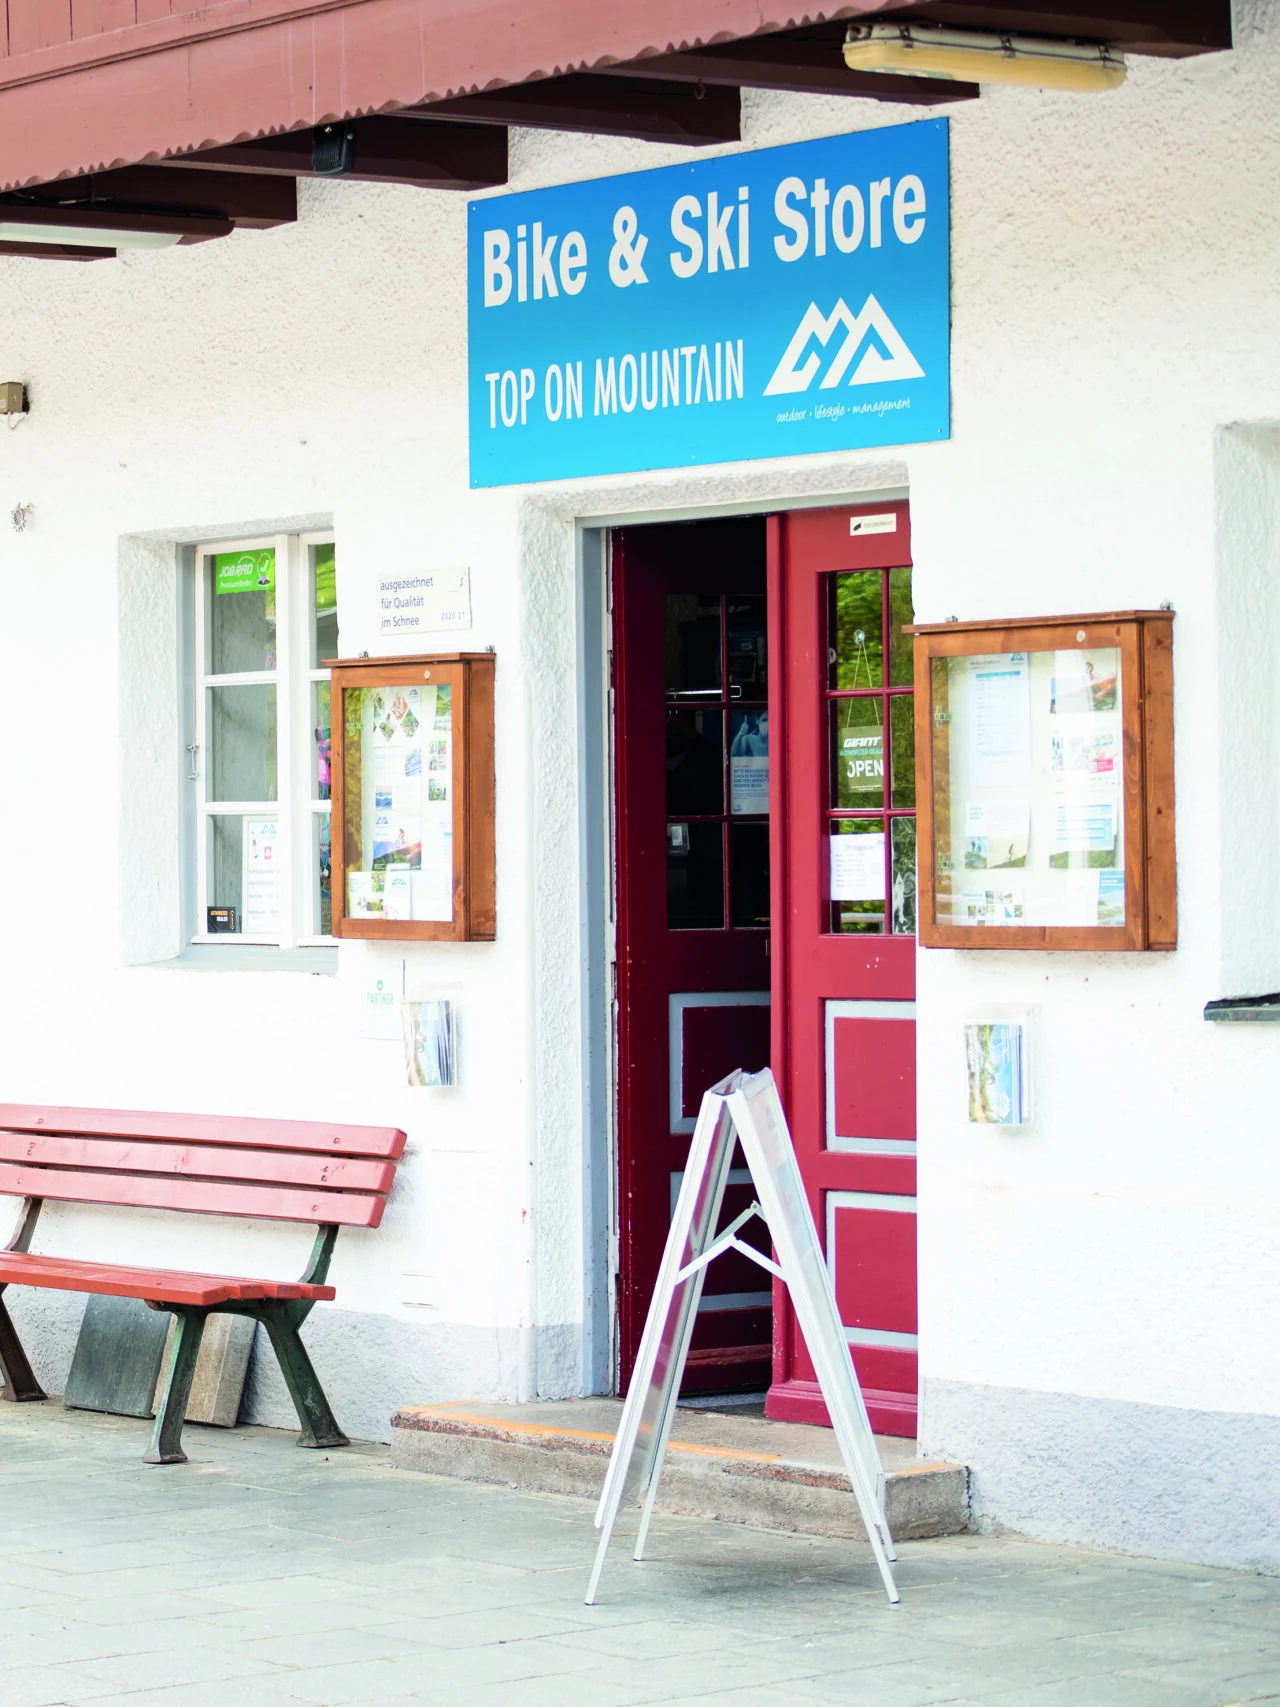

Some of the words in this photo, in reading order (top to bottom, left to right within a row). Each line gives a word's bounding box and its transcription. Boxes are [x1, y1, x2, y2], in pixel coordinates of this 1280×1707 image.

[483, 221, 588, 308] Bike
[608, 205, 649, 288] &
[669, 185, 750, 279] Ski
[773, 173, 927, 263] Store
[484, 368, 536, 429] TOP
[544, 361, 583, 422] ON
[593, 339, 744, 416] MOUNTAIN
[776, 407, 807, 423] outdoor
[814, 403, 845, 422] lifestyle
[852, 398, 911, 417] management
[380, 577, 433, 592] ausgezeichnet
[381, 597, 392, 609] für
[393, 596, 424, 609] Qualität
[381, 617, 391, 628] im
[393, 615, 420, 627] Schnee
[843, 736, 881, 748] GIANT
[847, 759, 884, 778] OPEN
